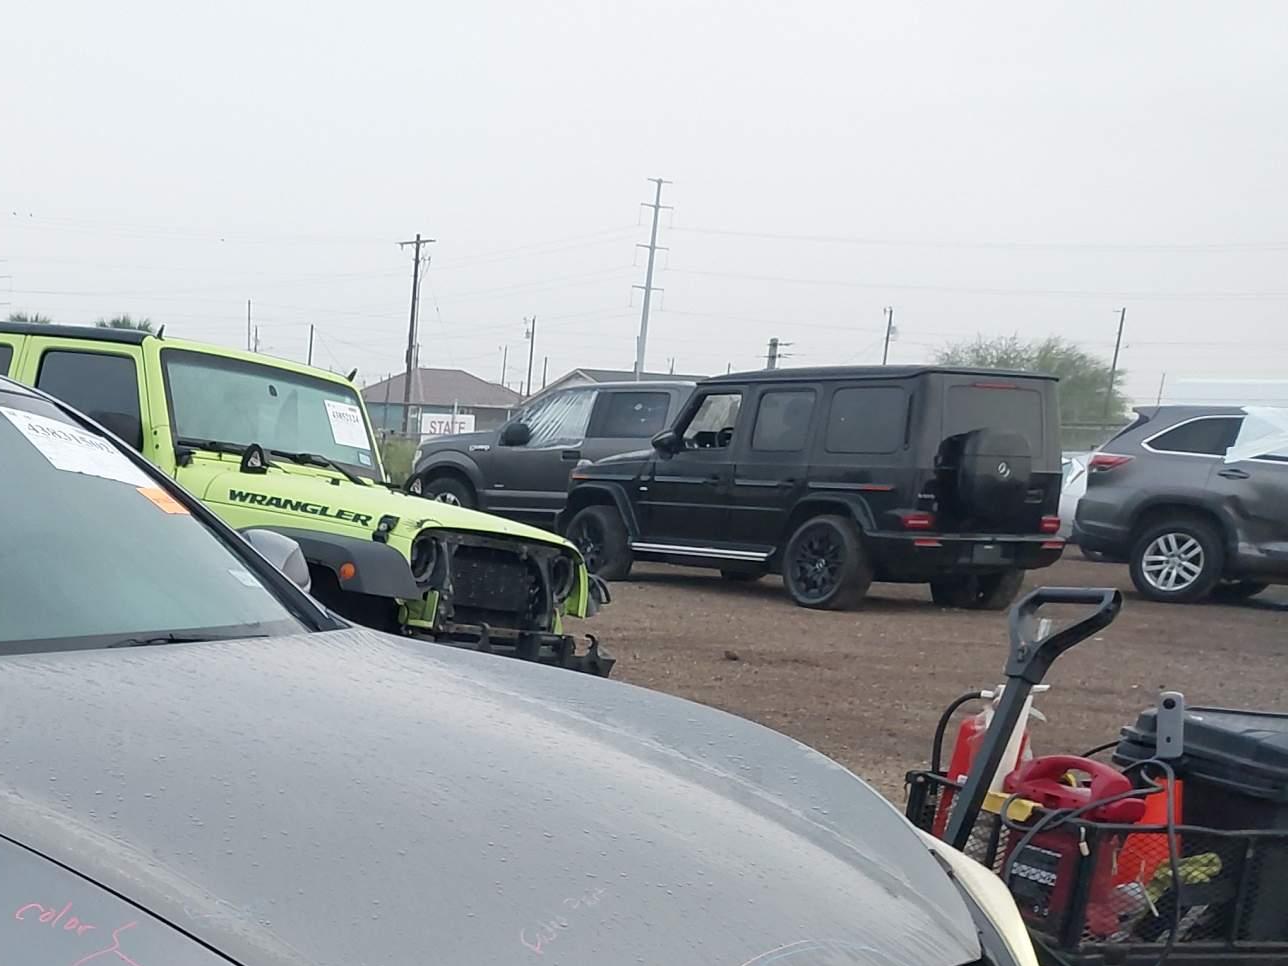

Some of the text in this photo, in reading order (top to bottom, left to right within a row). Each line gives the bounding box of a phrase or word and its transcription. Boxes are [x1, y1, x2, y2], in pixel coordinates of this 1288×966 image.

[429, 420, 467, 434] STATE
[228, 488, 374, 527] WRANGLER
[15, 900, 97, 936] color
